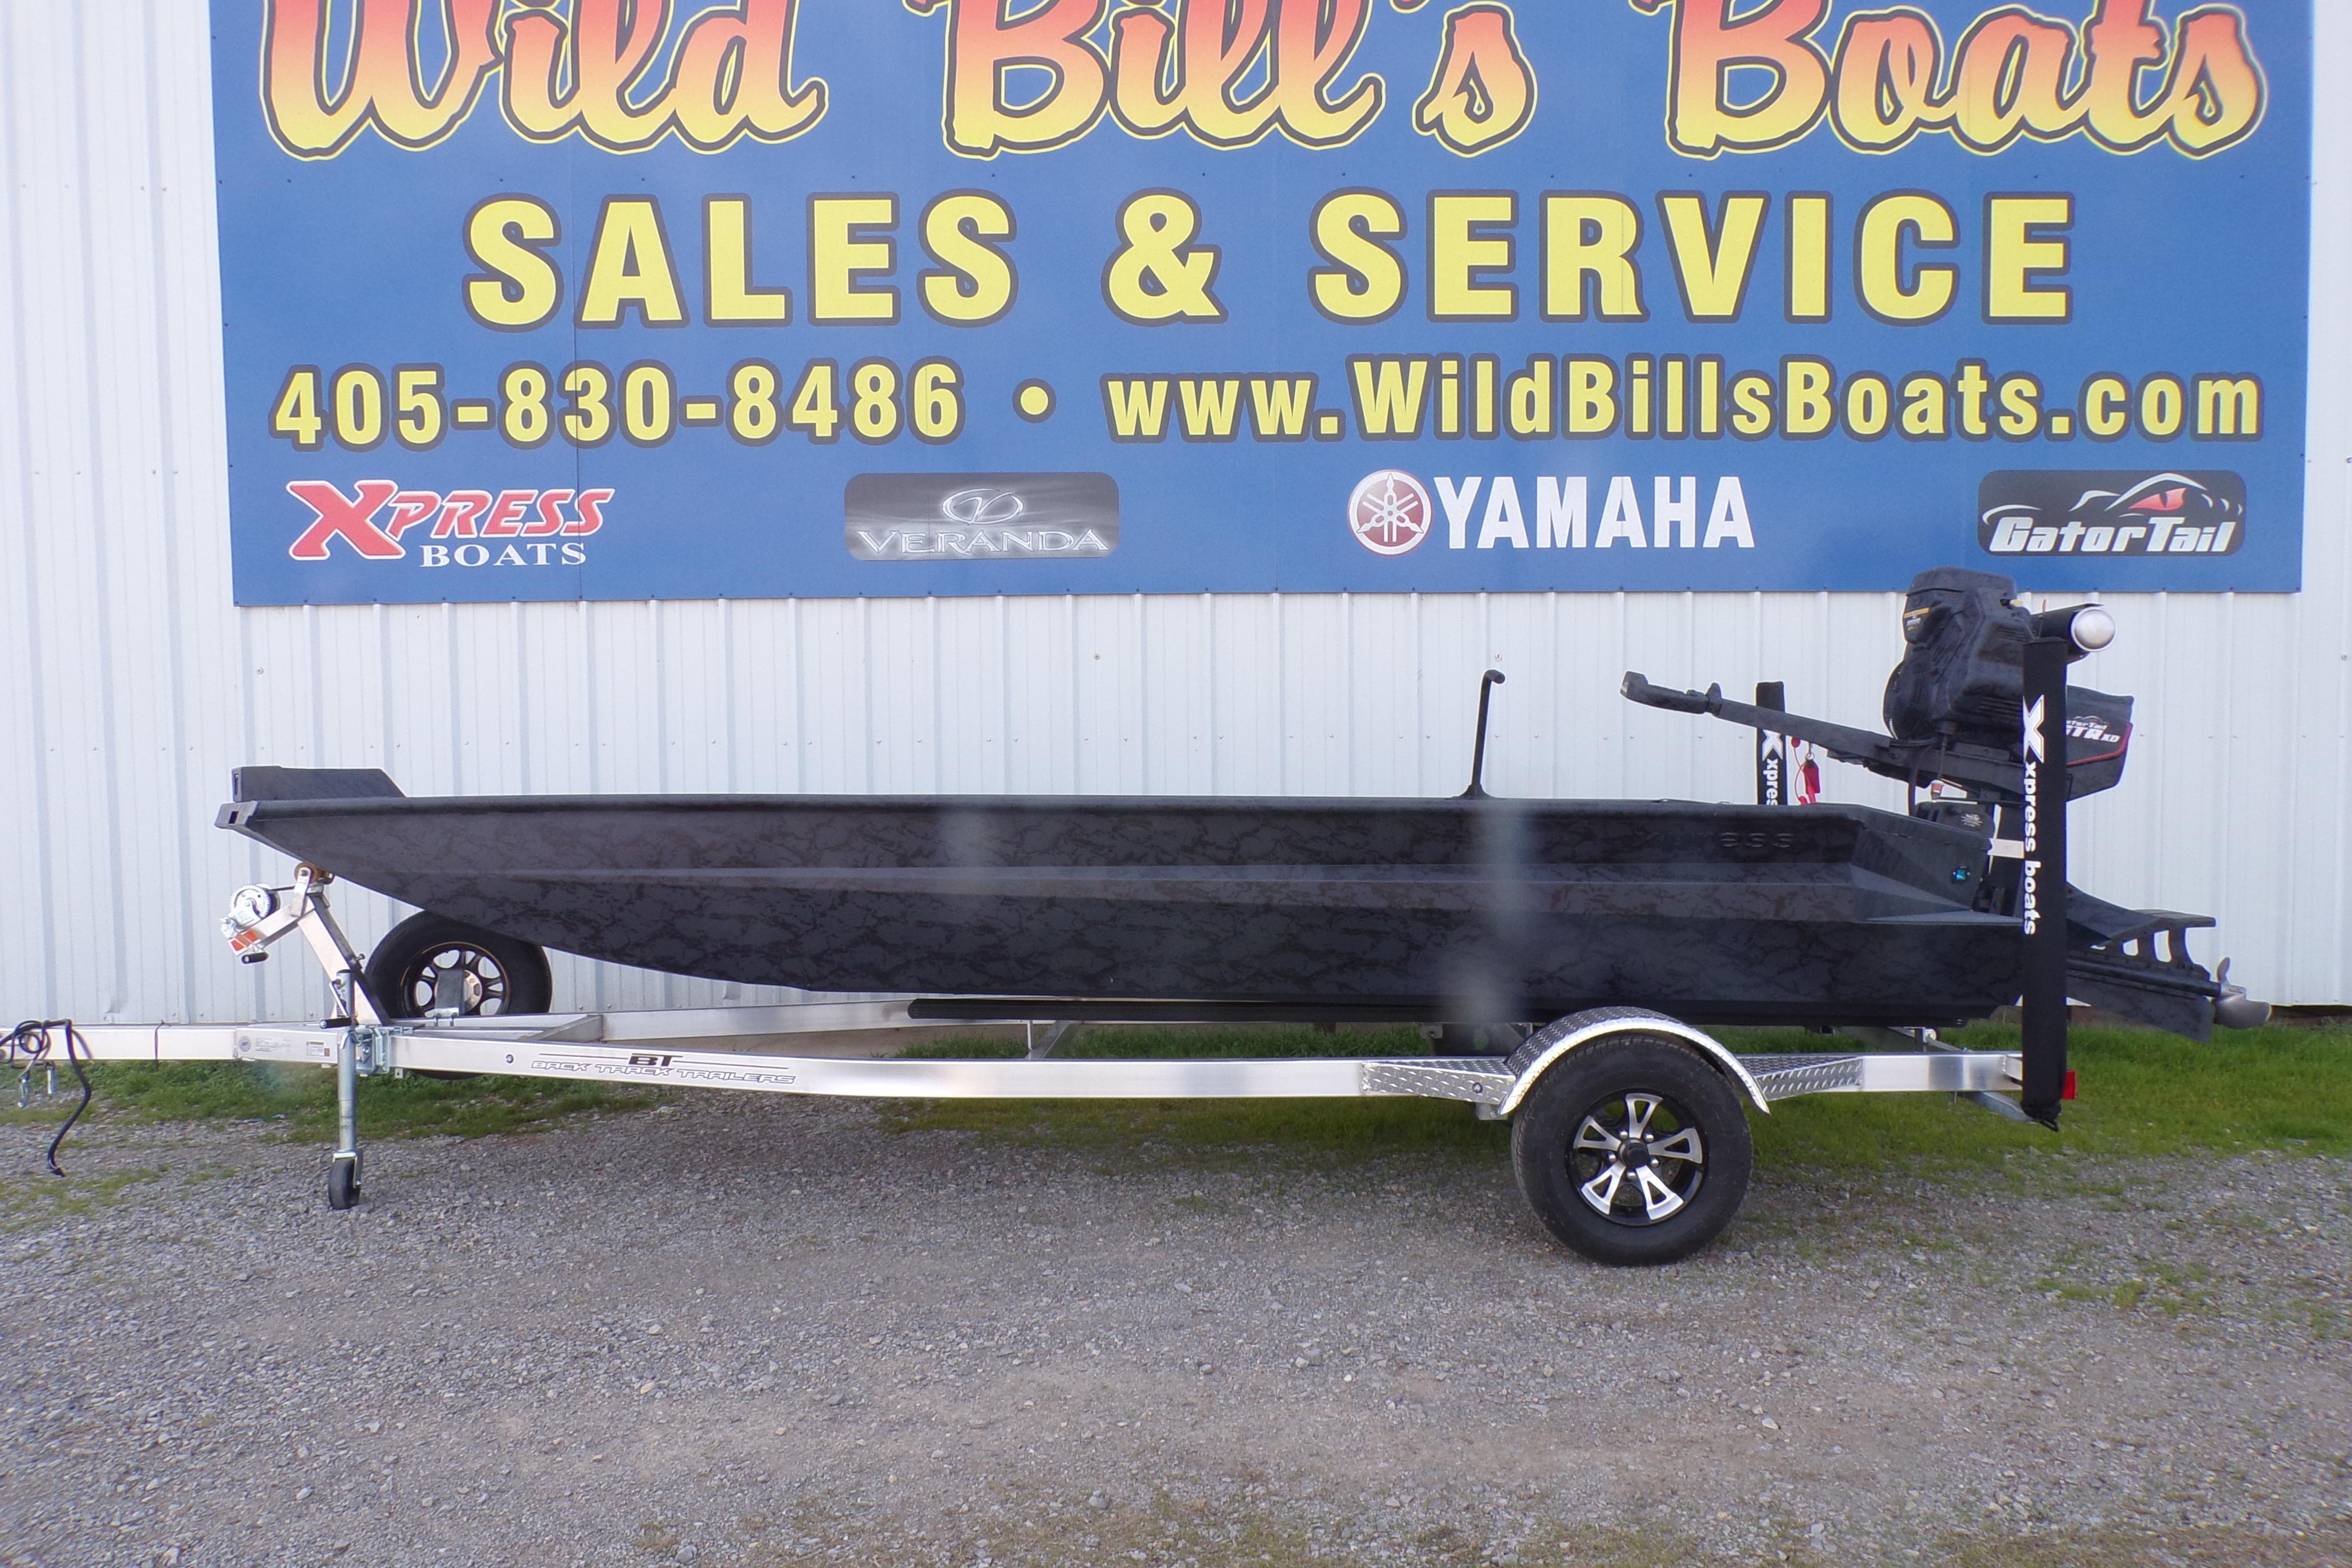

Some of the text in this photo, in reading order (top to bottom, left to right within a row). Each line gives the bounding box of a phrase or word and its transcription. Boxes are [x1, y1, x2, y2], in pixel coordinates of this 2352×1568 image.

[260, 0, 2268, 160] Wild Bills Boats
[463, 186, 2074, 331] SALES & SERVICE
[268, 352, 2264, 451] 405-830-8486 www.WildBillsBoats.com
[286, 480, 615, 560] XPRESS
[855, 528, 1110, 555] VERANDA
[1434, 476, 1755, 550] YAMAHA
[1989, 516, 2237, 552] GatorTail
[419, 542, 587, 568] BOATS
[2024, 761, 2037, 852] xpress
[2024, 860, 2042, 935] boats
[531, 1061, 797, 1084] BACK TRACK TRAILERS
[628, 1053, 683, 1067] BT
